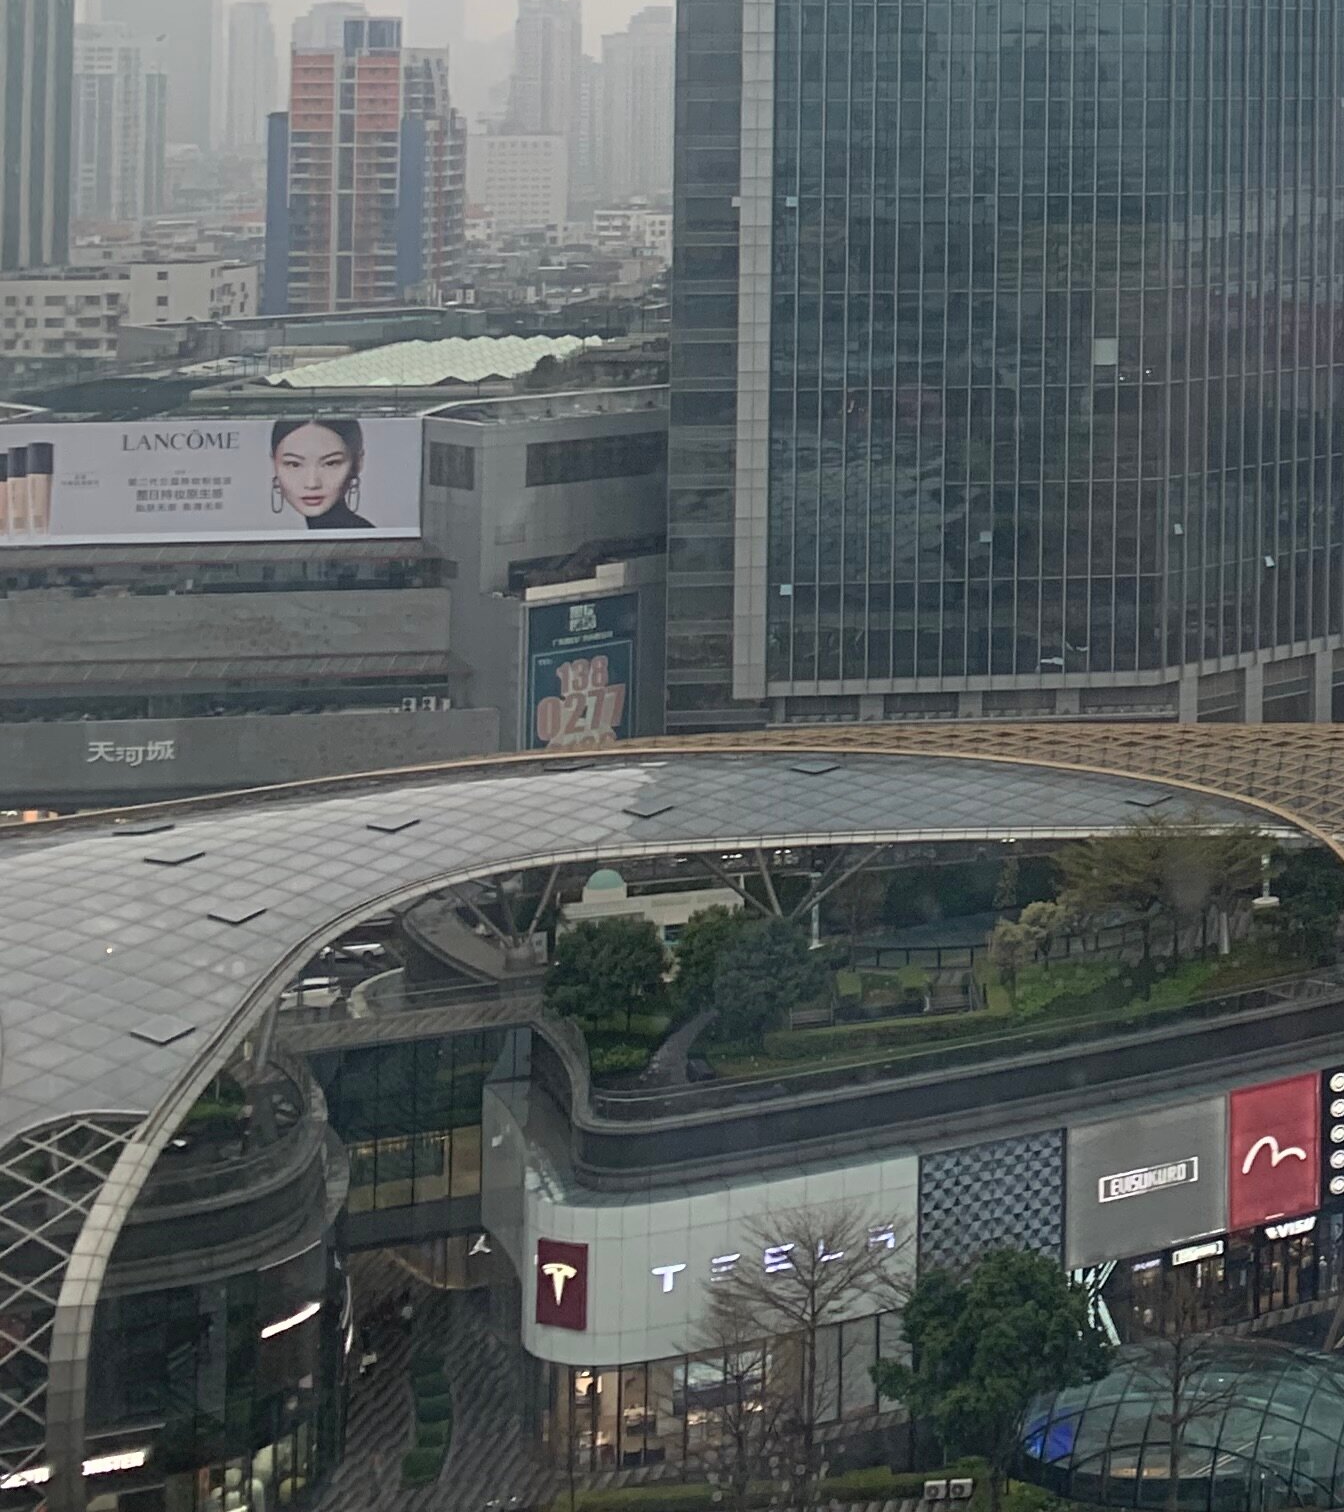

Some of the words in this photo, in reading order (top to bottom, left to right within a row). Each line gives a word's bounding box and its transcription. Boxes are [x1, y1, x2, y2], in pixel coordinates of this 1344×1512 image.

[122, 429, 241, 451] LANCÔME
[556, 655, 609, 695] 138
[537, 683, 626, 741] 0277
[86, 739, 176, 767] 天河城
